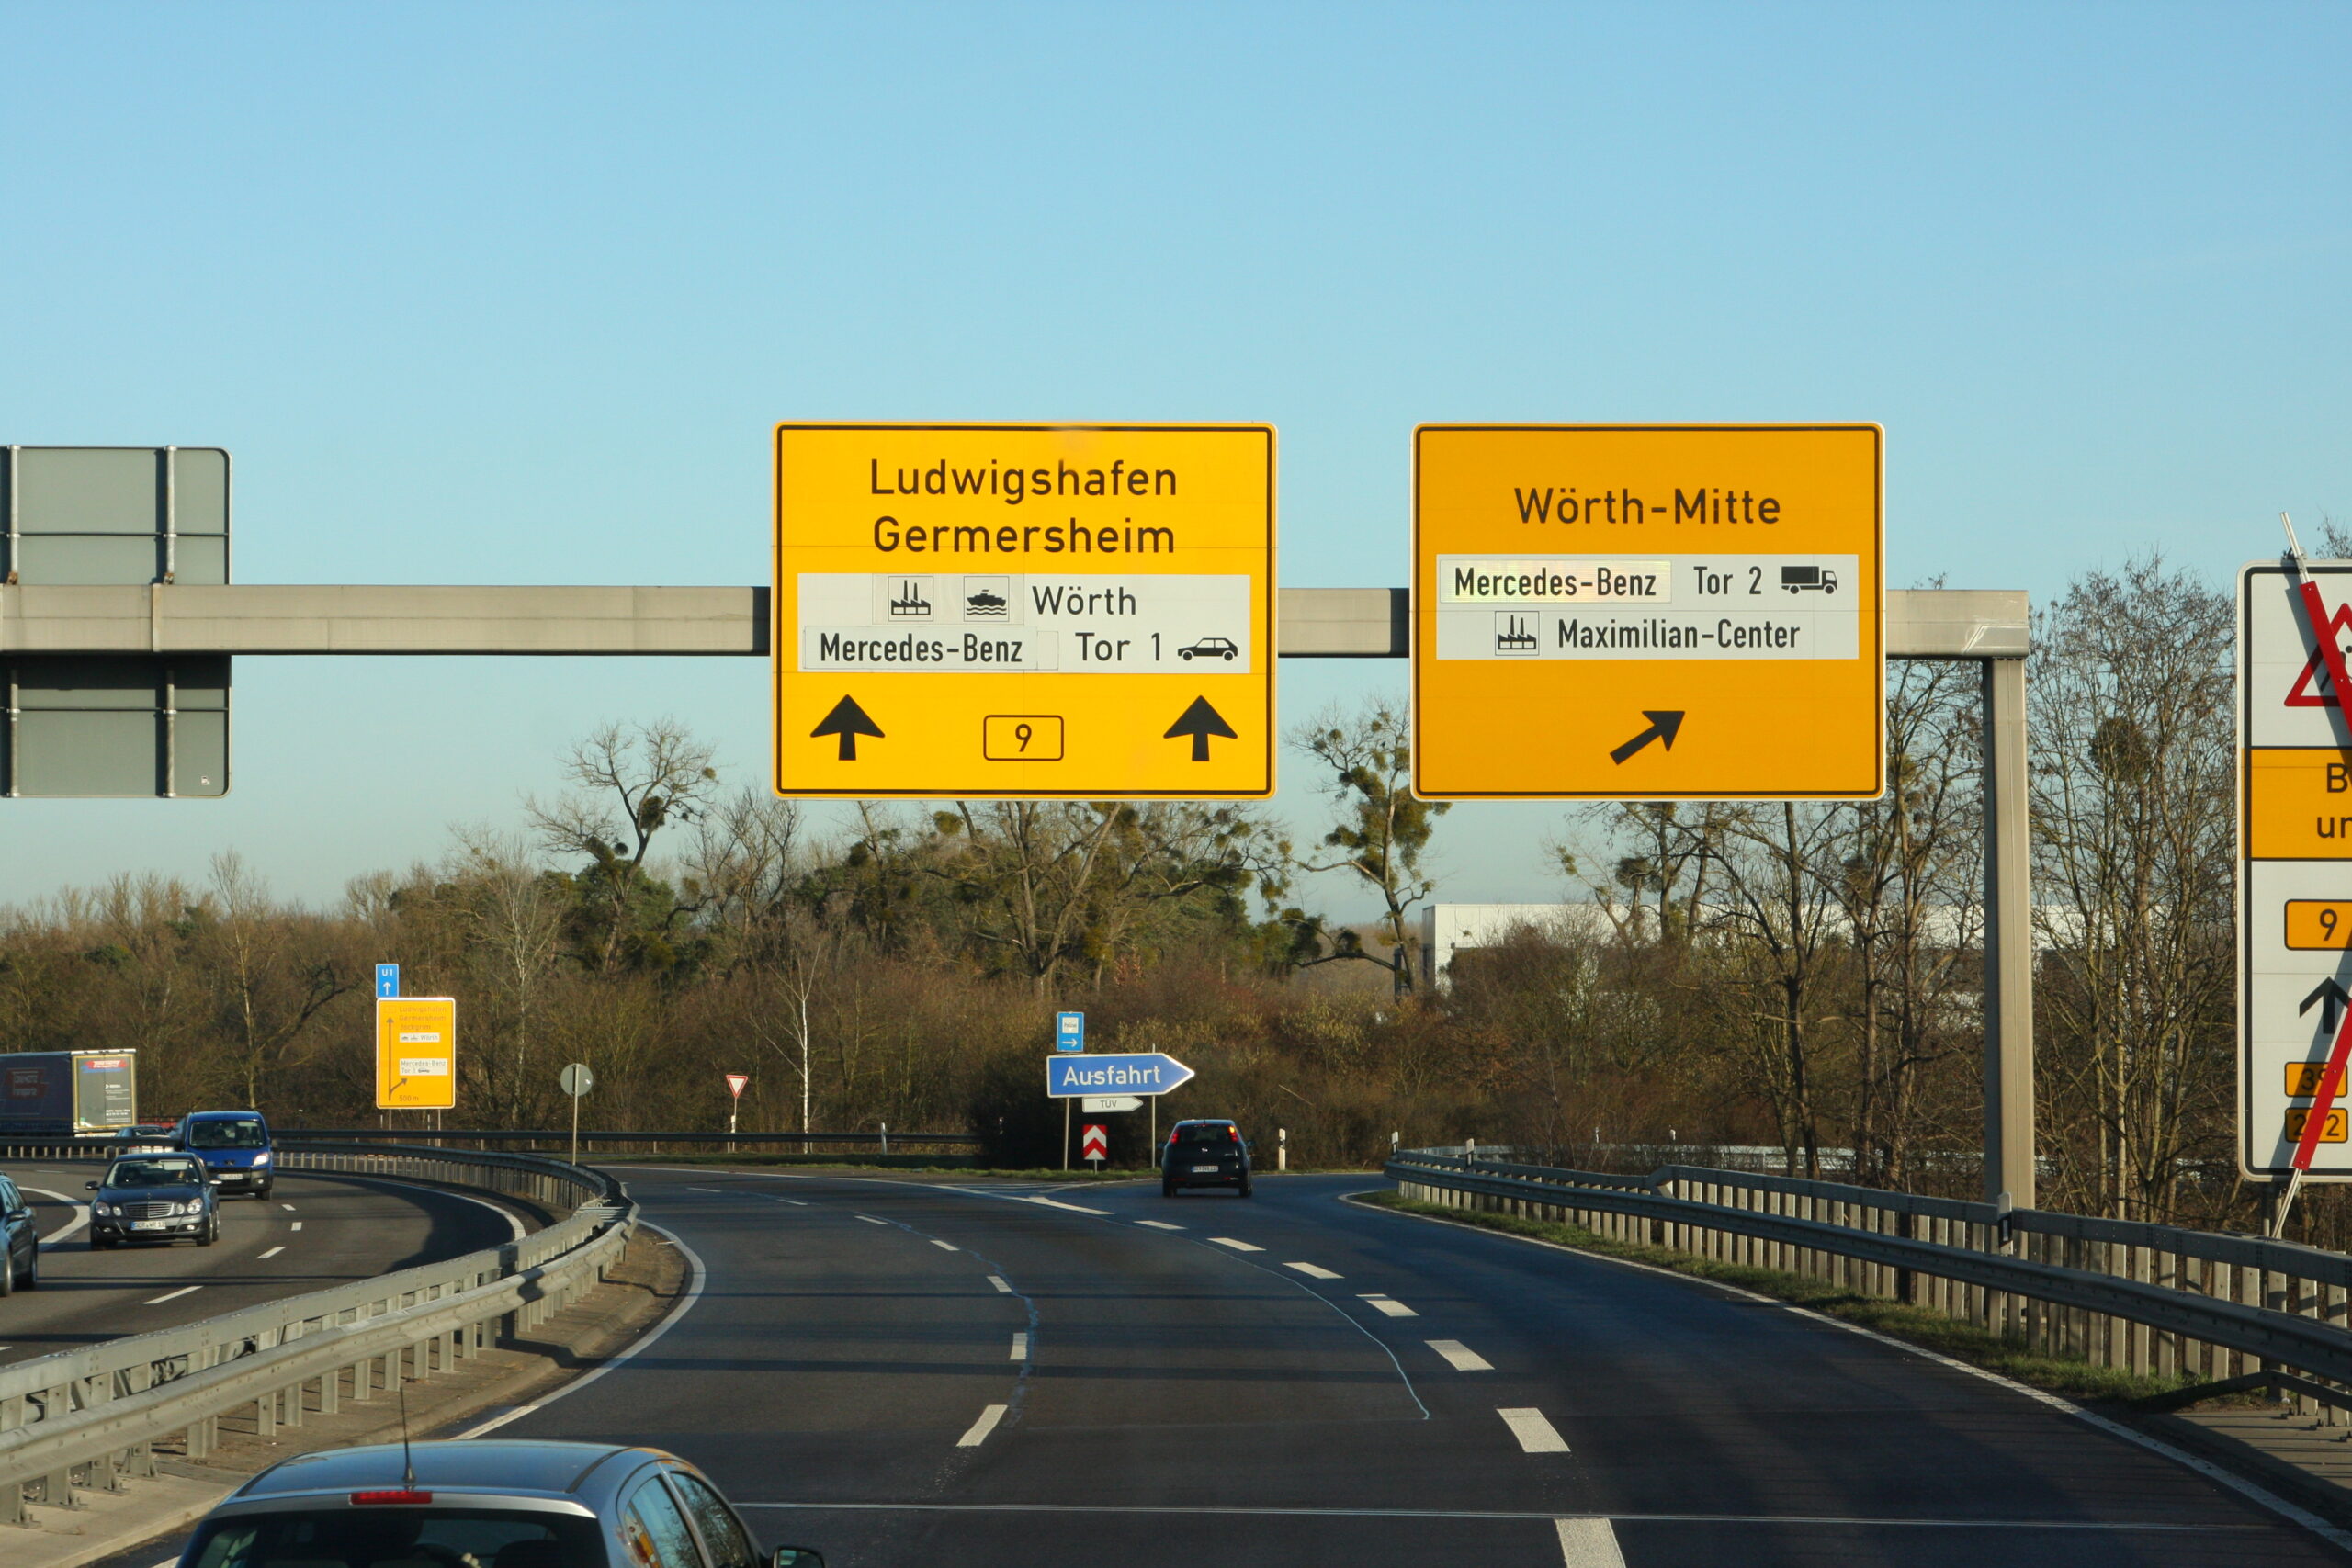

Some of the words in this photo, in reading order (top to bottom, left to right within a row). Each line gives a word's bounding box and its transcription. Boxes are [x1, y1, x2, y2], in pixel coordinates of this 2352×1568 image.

[871, 458, 1177, 505] Ludwigshafen
[1514, 487, 1781, 525] Wörth-Mitte
[873, 515, 1174, 553] Germersheim
[1454, 567, 1657, 596] Mercedes-Benz
[1693, 566, 1734, 595] Tor
[1748, 566, 1762, 595] 2
[1032, 585, 1136, 615] Wörth
[820, 632, 1023, 662] Mercedes-Benz
[1075, 632, 1131, 661] Tor
[1151, 632, 1161, 661] 1
[1558, 618, 1801, 649] Maximilian-Center
[1014, 723, 1033, 752] 9
[2319, 908, 2338, 942] 9
[381, 968, 393, 976] U1
[1062, 1065, 1162, 1086] Ausfahrt
[1099, 1099, 1118, 1109] TÜV
[2293, 1113, 2340, 1137] 22
